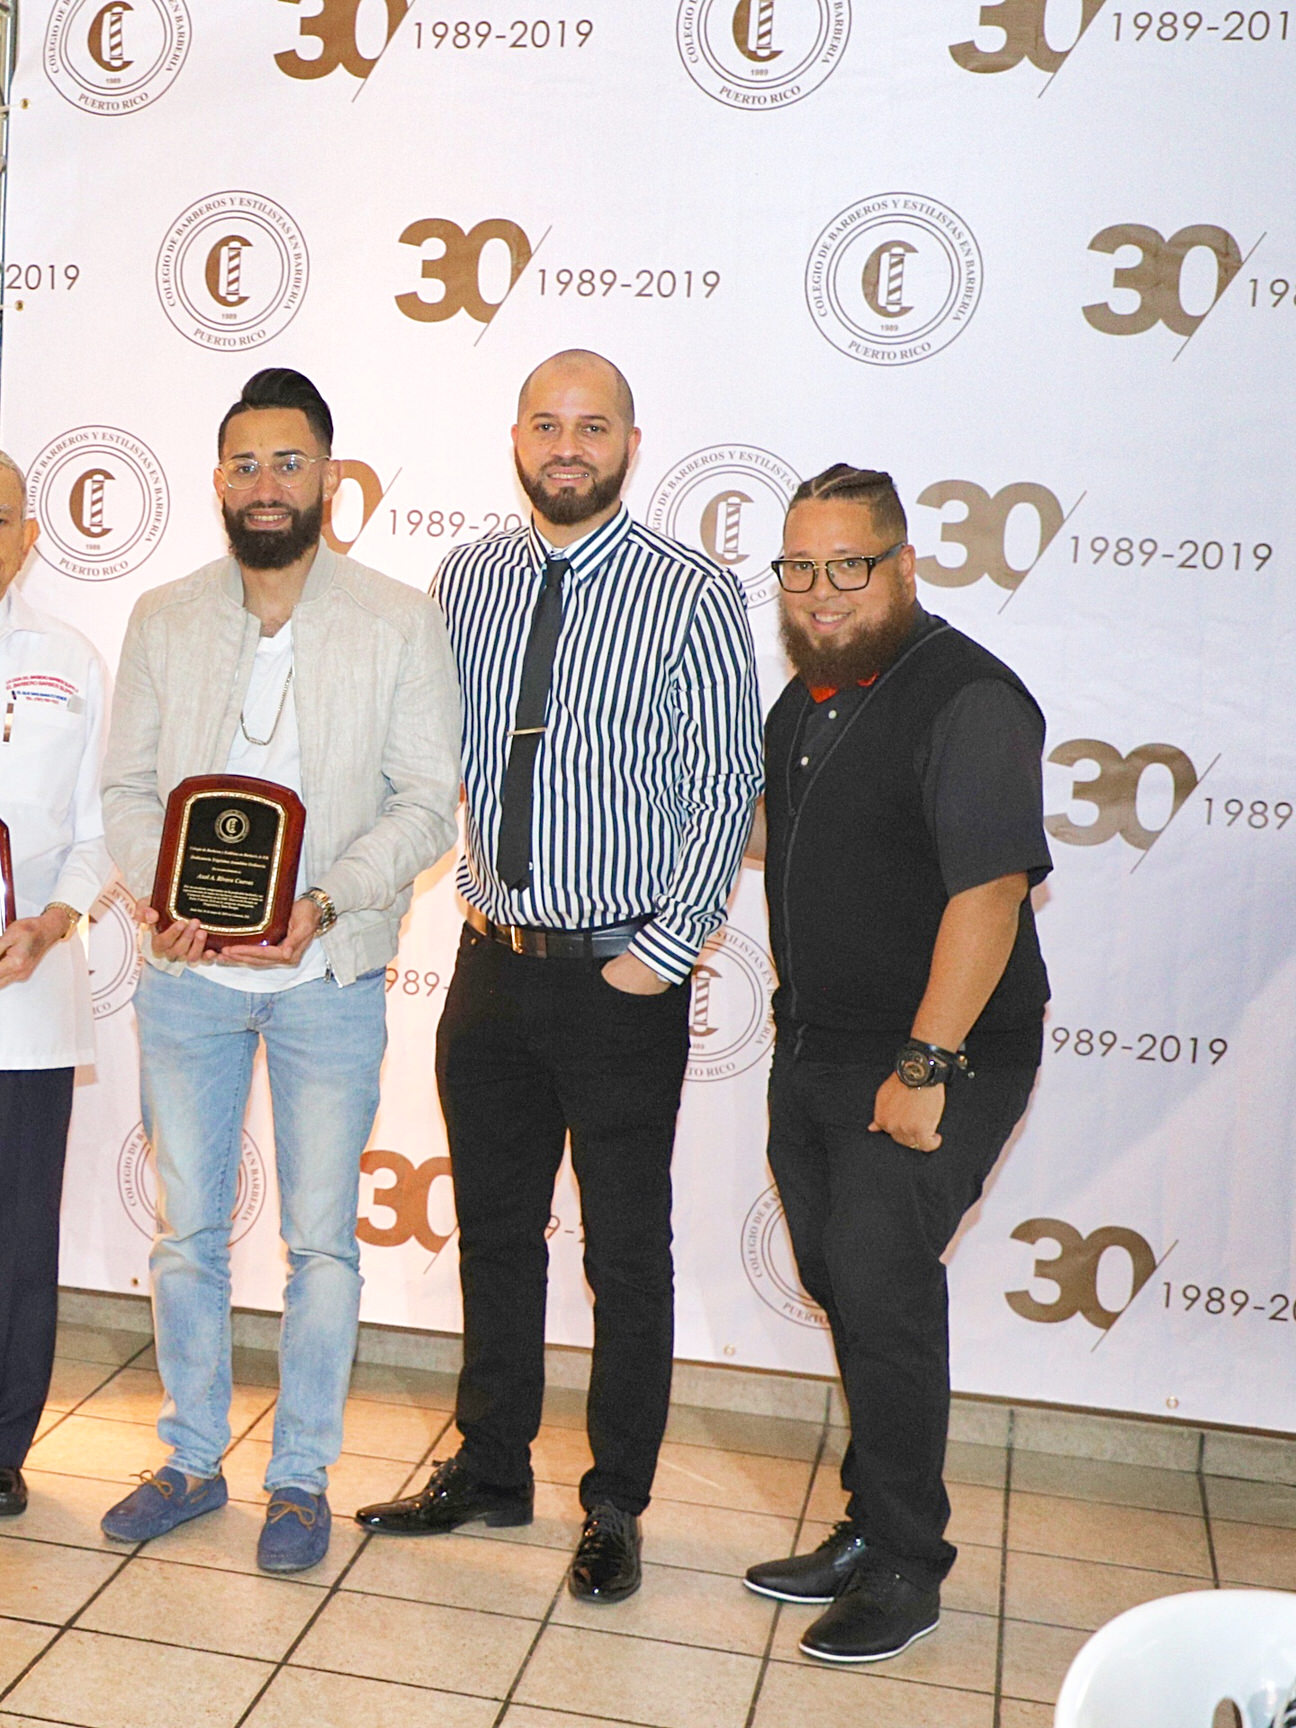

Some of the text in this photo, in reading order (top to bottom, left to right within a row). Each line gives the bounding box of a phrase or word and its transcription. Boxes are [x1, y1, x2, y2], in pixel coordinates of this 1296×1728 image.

[48, 7, 65, 74] COLEGIO DE
[414, 19, 593, 50] 1989-2019
[683, 7, 699, 63] COLEGIO
[78, 92, 149, 111] PUERTO RICO
[719, 85, 801, 105] PUERTO RICO
[828, 200, 888, 242] BARBEROS
[892, 199, 900, 208] Y
[903, 199, 963, 241] ESTILISTAS
[162, 254, 176, 308] COLEGIO
[169, 237, 178, 253] DE
[175, 198, 226, 236] BARBEROS
[229, 197, 237, 206] Y
[239, 198, 291, 235] ESTILISTAS
[288, 234, 300, 251] EN
[818, 242, 832, 259] DE
[959, 240, 972, 258] EN
[6, 263, 80, 290] 2019
[394, 217, 721, 324] 30 1989-2019
[811, 261, 827, 318] COLEGIO
[1081, 223, 1243, 337] 30
[193, 328, 266, 347] PUERTO RICO
[847, 340, 932, 360] PUERTO RICO
[40, 433, 89, 468] BARBEROS
[92, 432, 100, 440] Y
[102, 432, 152, 469] ESTILISTAS
[149, 469, 161, 485] EN
[660, 451, 796, 507] DE BARBEROS Y ESTILISTAS
[390, 509, 522, 538] 1989-20
[915, 479, 1273, 591] 30 1989-2019
[59, 557, 129, 576] PUERTO RICO
[1043, 738, 1198, 850] 30
[715, 931, 765, 969] STILISTAS
[92, 1002, 111, 1015] ICO
[1051, 1027, 1228, 1065] 989-2019
[707, 1063, 735, 1077] RICO
[1004, 1217, 1296, 1330] 30 1989-2
